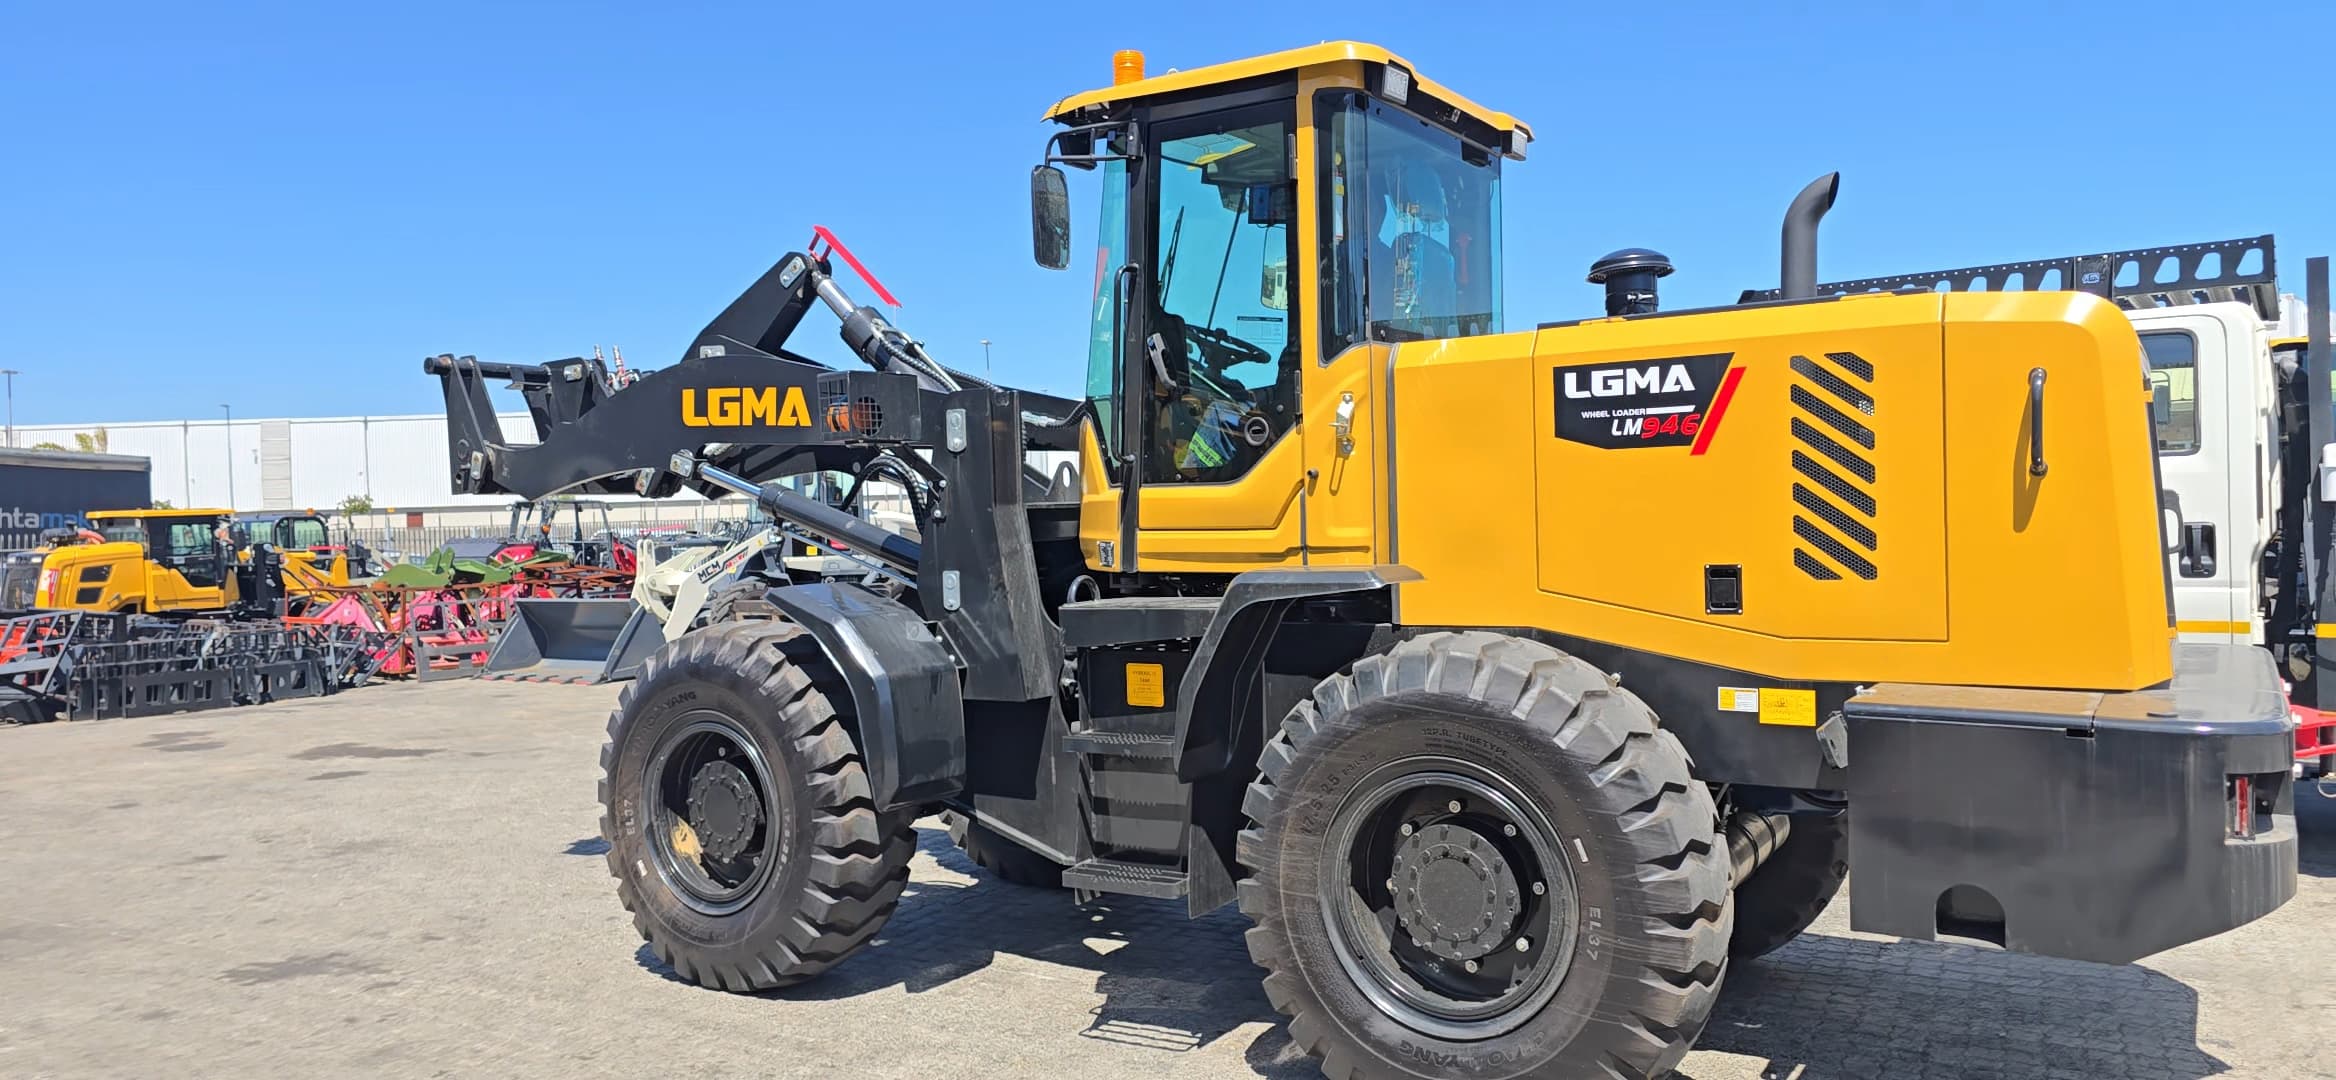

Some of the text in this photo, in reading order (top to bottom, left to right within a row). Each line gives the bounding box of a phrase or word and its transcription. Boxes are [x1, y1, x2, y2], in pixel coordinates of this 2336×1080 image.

[1564, 364, 1696, 399] LGMA
[682, 387, 812, 427] LGMA
[1581, 408, 1646, 419] WHEEL LOADER
[1611, 414, 1701, 439] LM946
[1586, 906, 1602, 961] EL37
